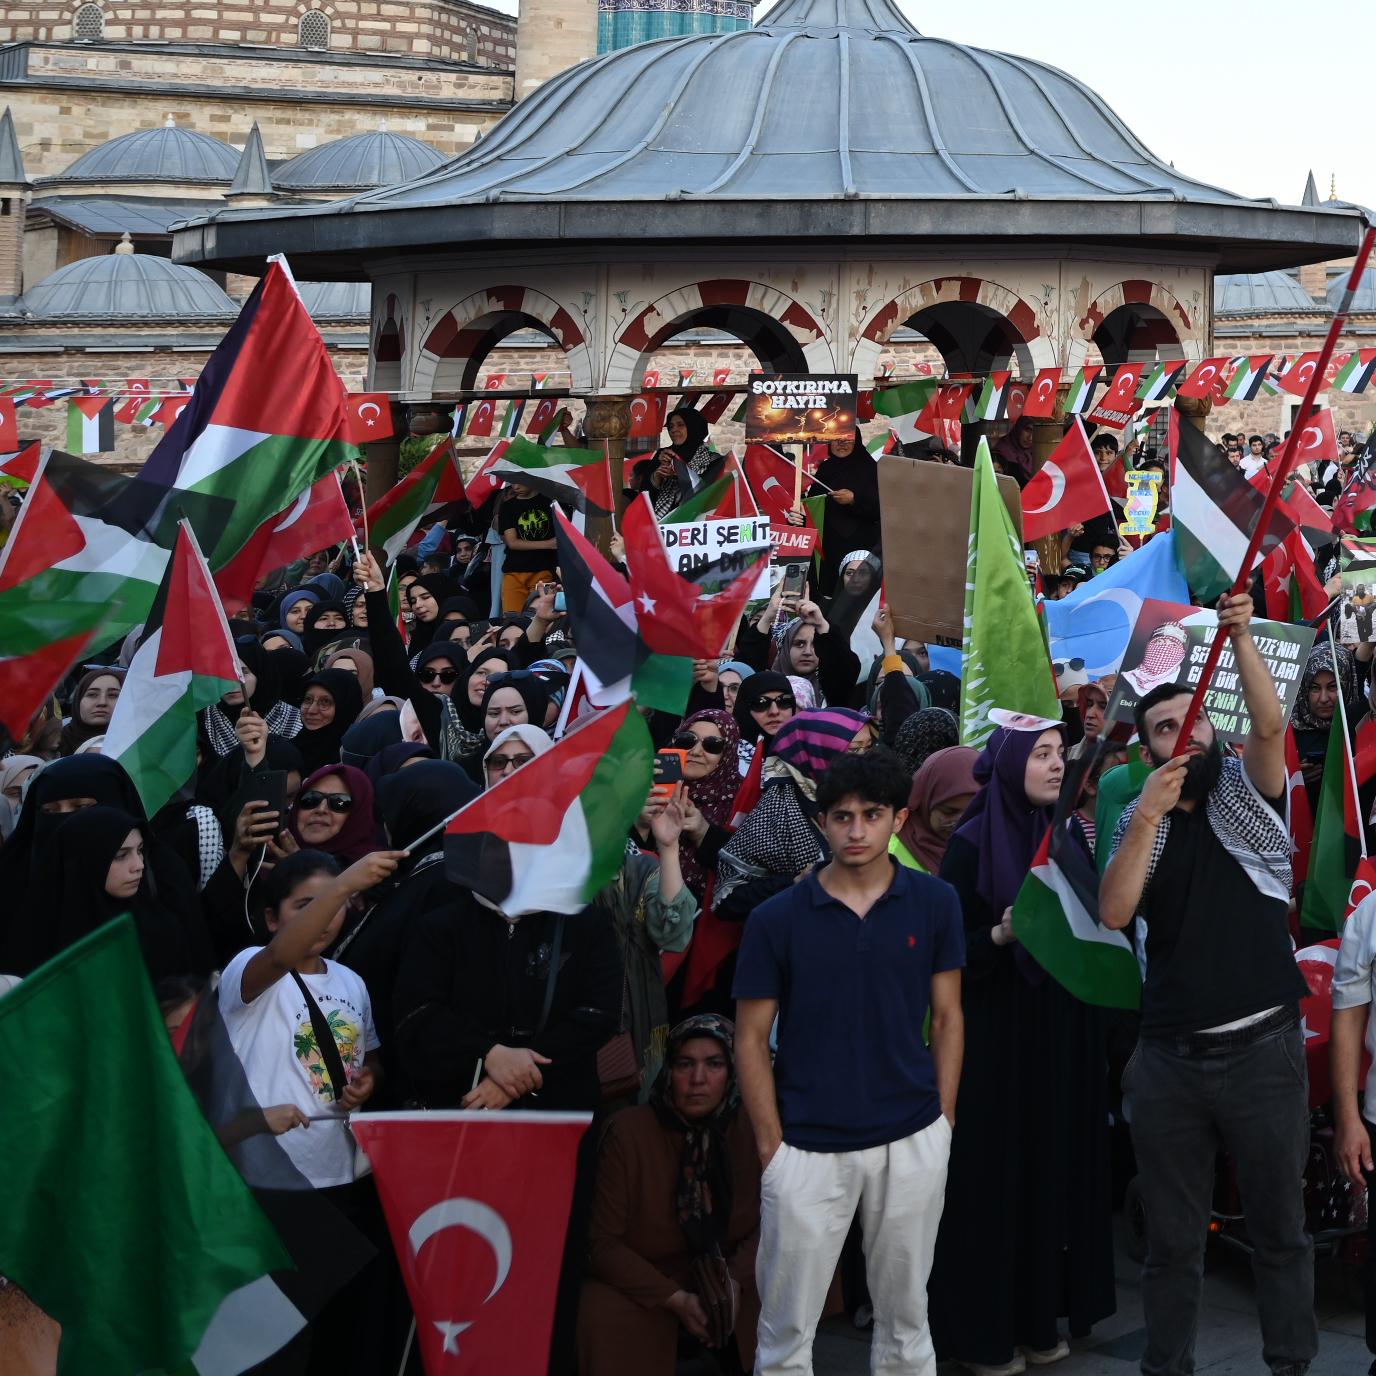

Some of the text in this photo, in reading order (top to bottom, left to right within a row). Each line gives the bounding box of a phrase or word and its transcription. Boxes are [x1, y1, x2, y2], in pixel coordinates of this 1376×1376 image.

[752, 380, 853, 395] SOYKIRIMA
[771, 394, 828, 409] HAYIR
[661, 520, 770, 548] İDERİ ŞEHİT
